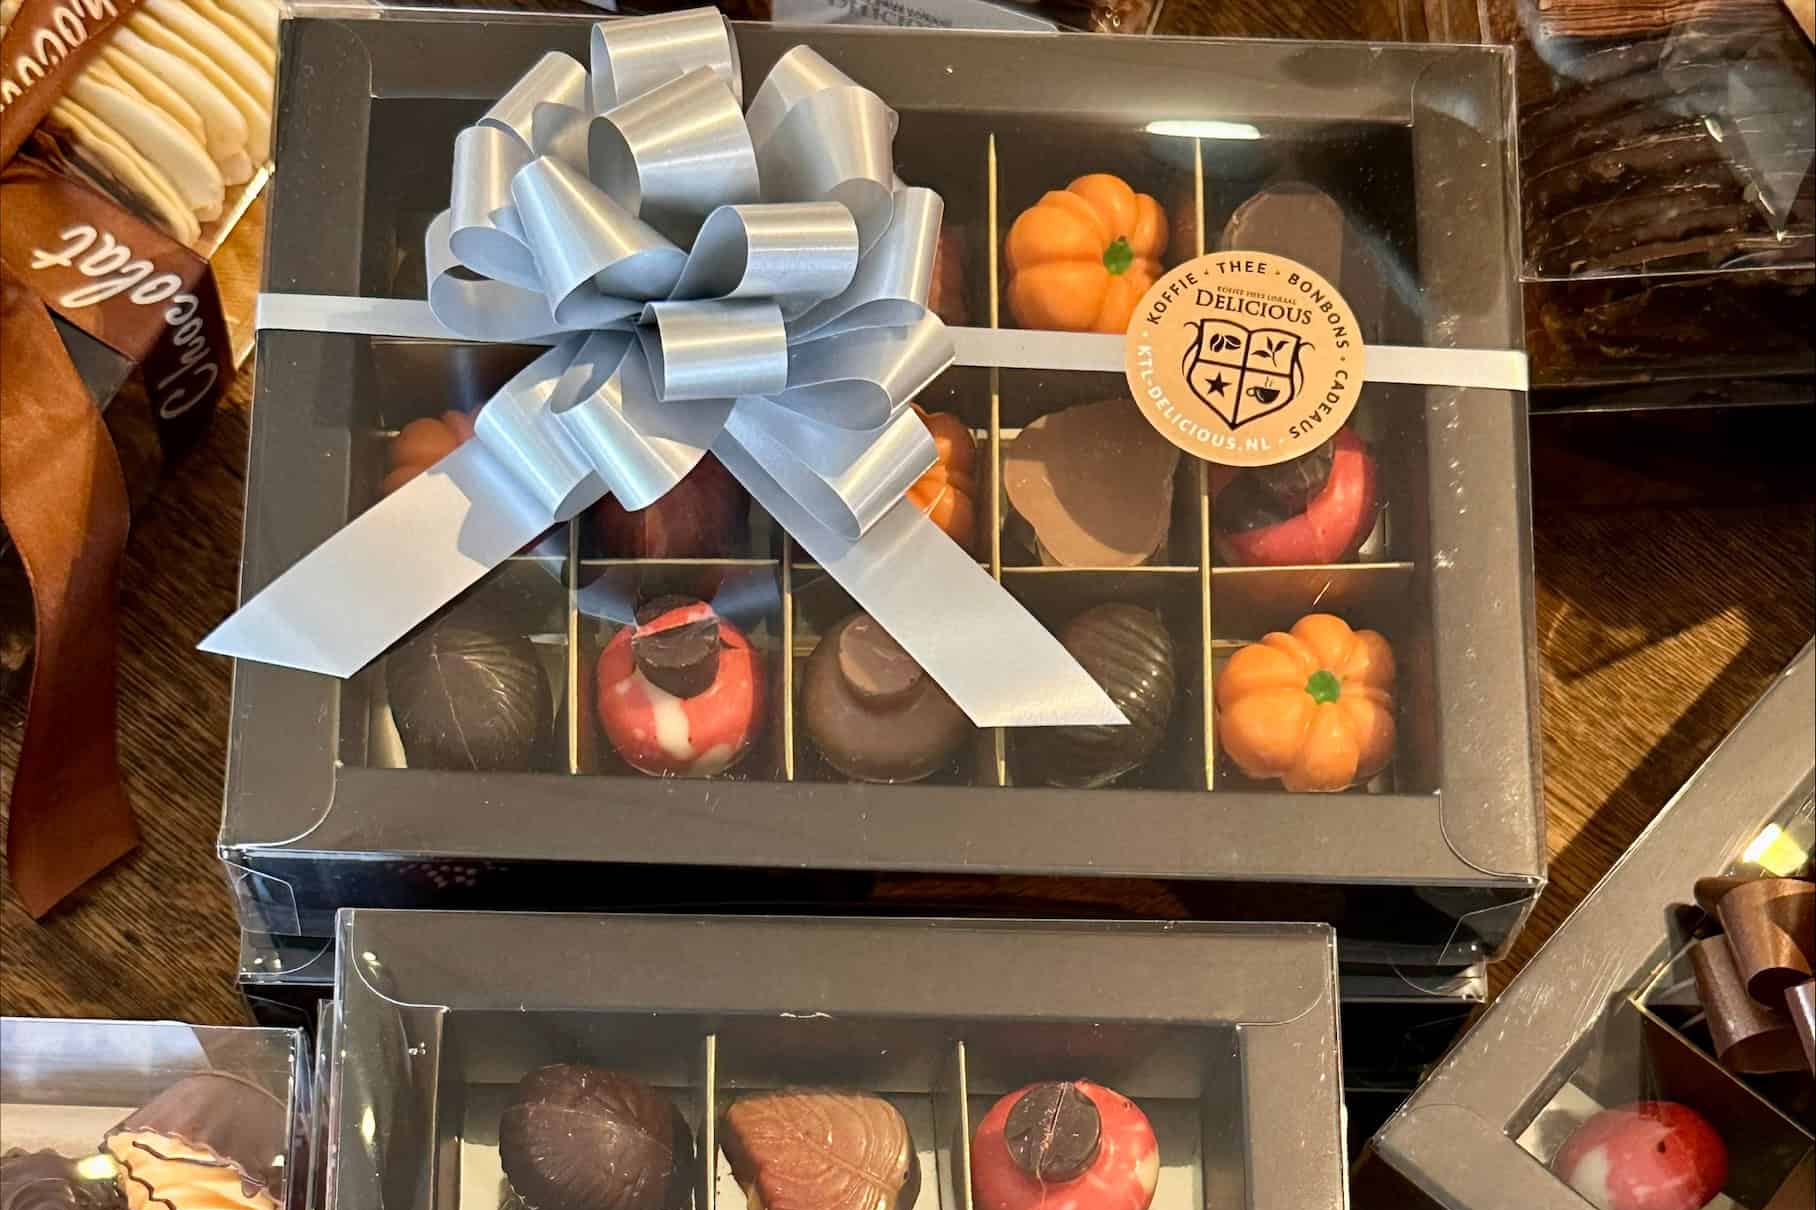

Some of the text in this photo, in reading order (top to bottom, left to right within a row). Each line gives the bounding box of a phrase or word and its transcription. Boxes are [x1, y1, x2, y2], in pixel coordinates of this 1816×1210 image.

[32, 225, 218, 420] Chocolat
[1146, 260, 1350, 439] KOFFIE THEE BONBONS CADEAUS
[1195, 288, 1313, 325] DELICIOUS
[1137, 344, 1271, 451] KTL-DELICIOUS.NL
